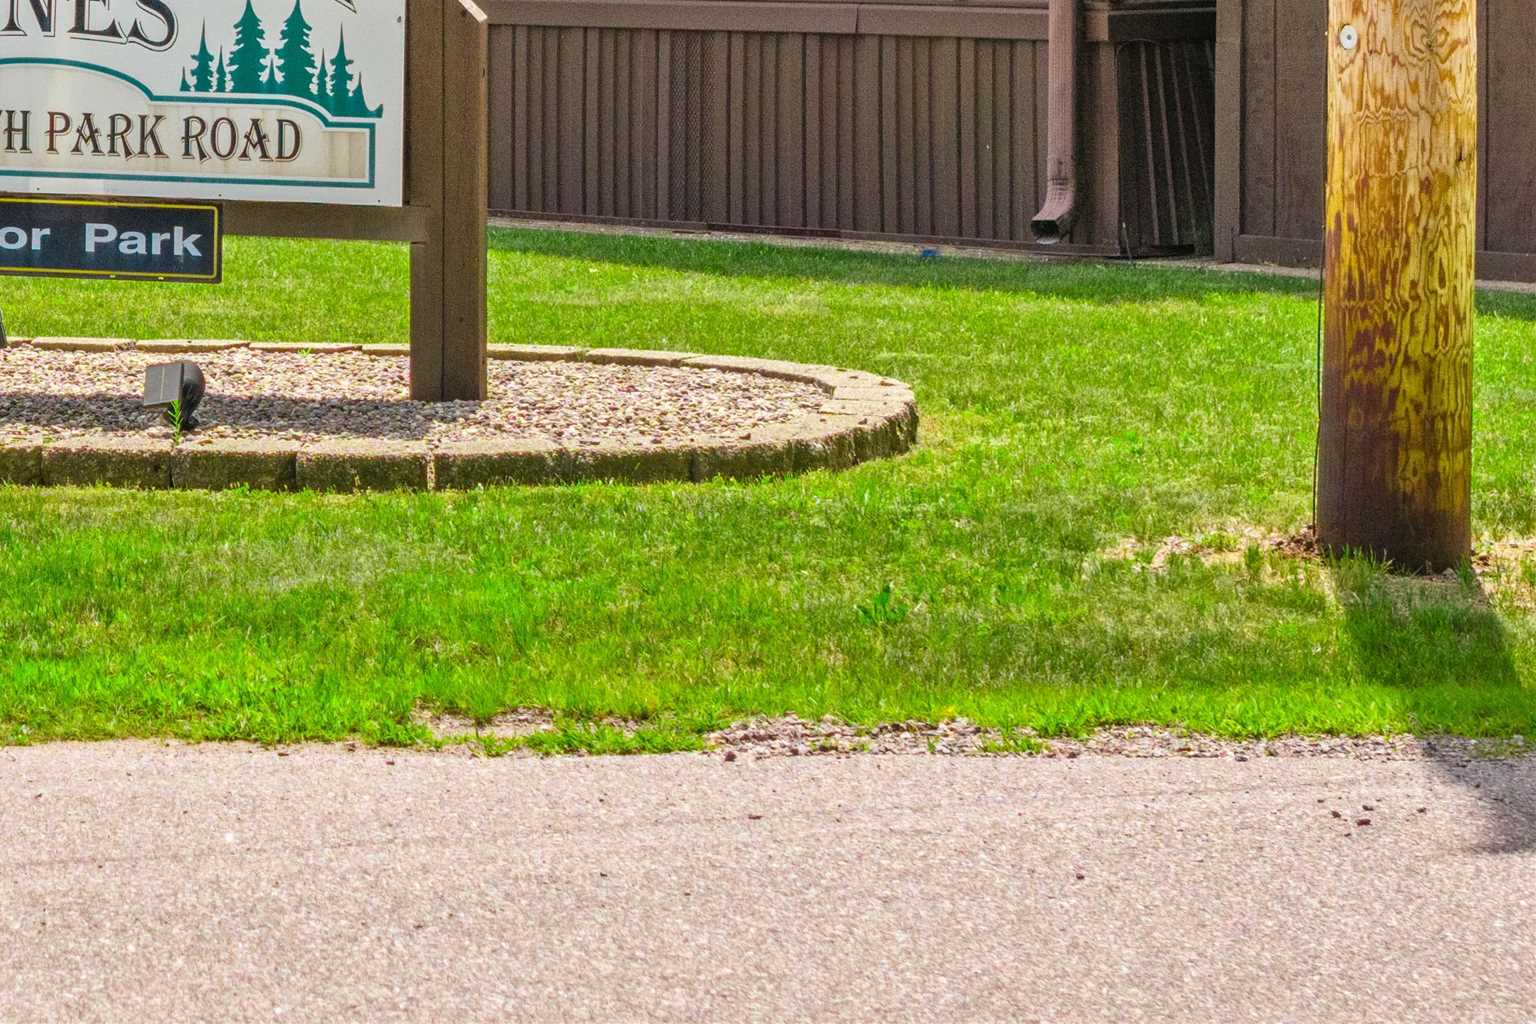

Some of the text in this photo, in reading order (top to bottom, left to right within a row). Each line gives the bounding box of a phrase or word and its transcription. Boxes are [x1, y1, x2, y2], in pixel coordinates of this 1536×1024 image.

[44, 111, 170, 162] PARK
[180, 116, 303, 165] ROAD
[84, 222, 203, 258] Park
